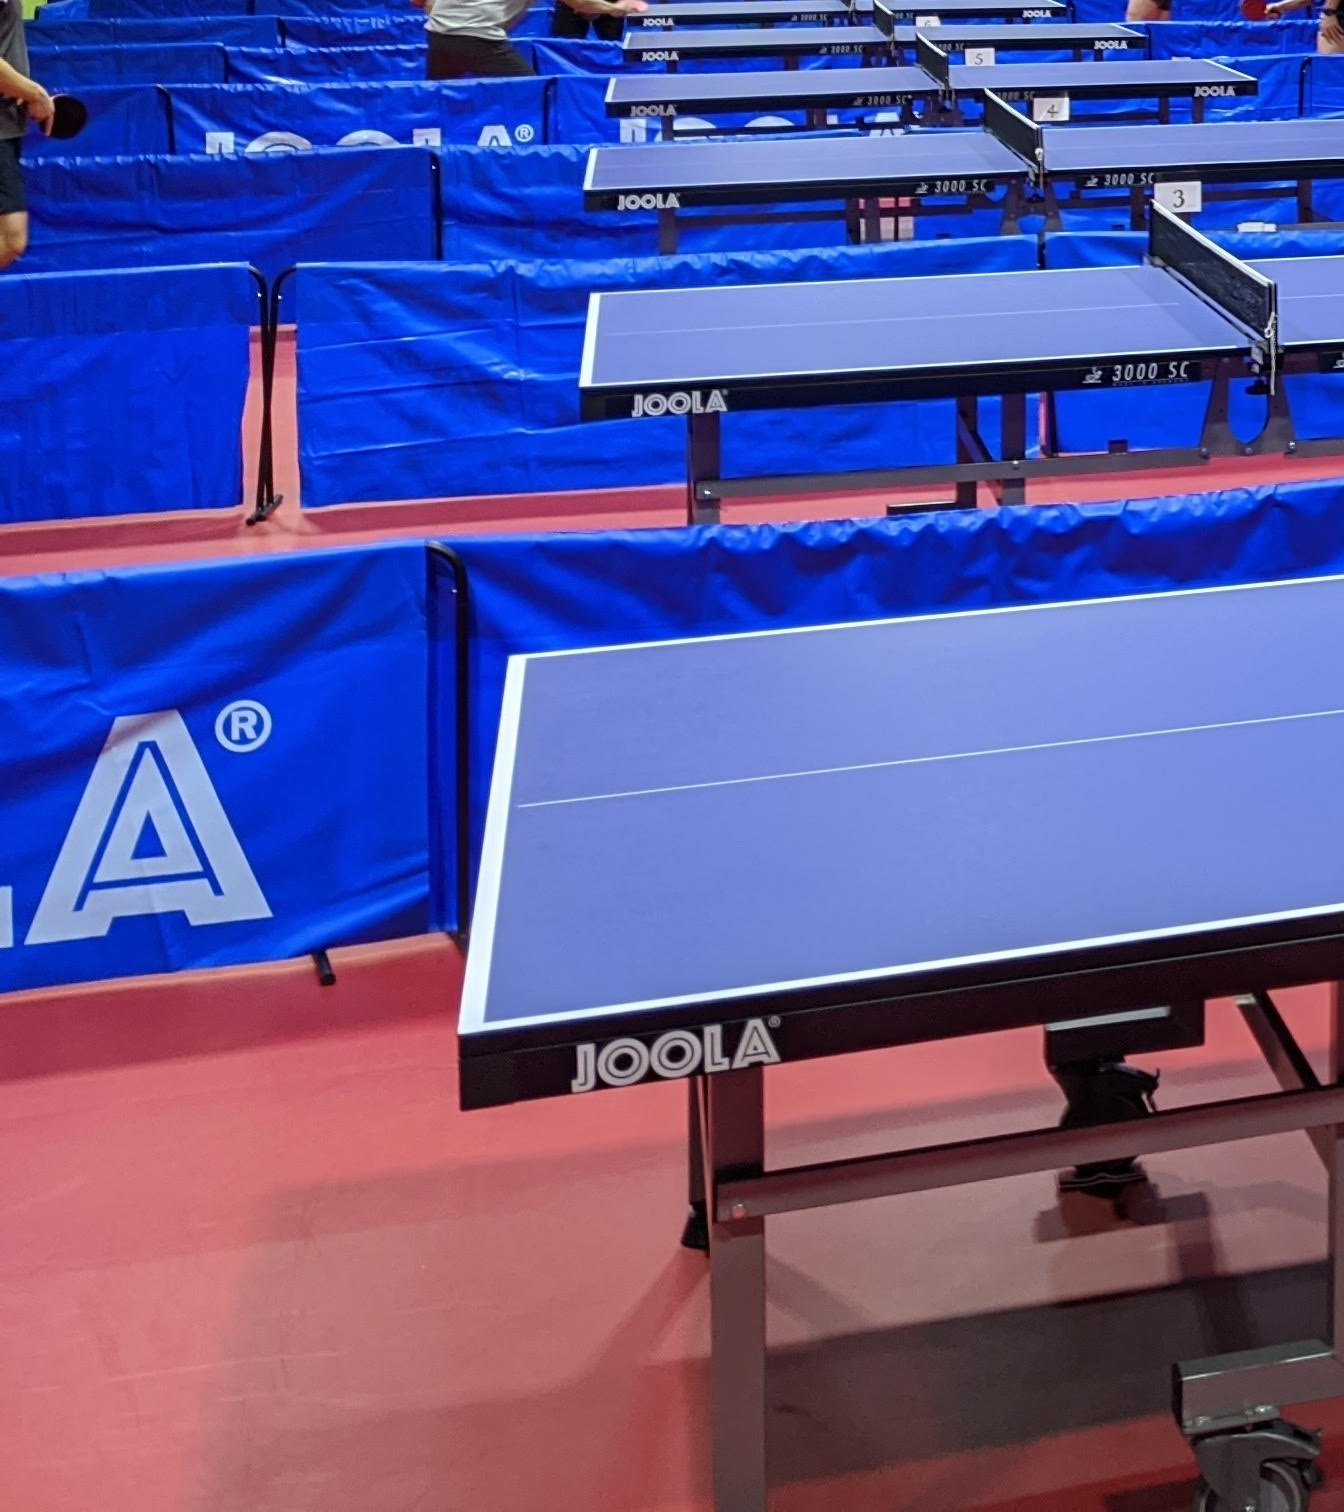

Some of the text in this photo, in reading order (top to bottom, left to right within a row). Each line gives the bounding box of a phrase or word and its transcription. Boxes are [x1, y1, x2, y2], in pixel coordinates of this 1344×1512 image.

[1094, 40, 1129, 51] JOOLA
[642, 51, 679, 62] JOOLA
[974, 53, 984, 65] 5
[1194, 85, 1236, 97] JOOLA
[630, 104, 676, 117] JOOLA
[1047, 104, 1059, 118] 4
[1104, 172, 1155, 185] 3000 SC
[934, 179, 987, 193] 3000 SC
[617, 193, 680, 210] JOOLA
[1173, 189, 1184, 208] 3
[1112, 361, 1190, 381] 3000 SC
[631, 390, 727, 417] JOOLA
[571, 1018, 781, 1093] JOOLA
